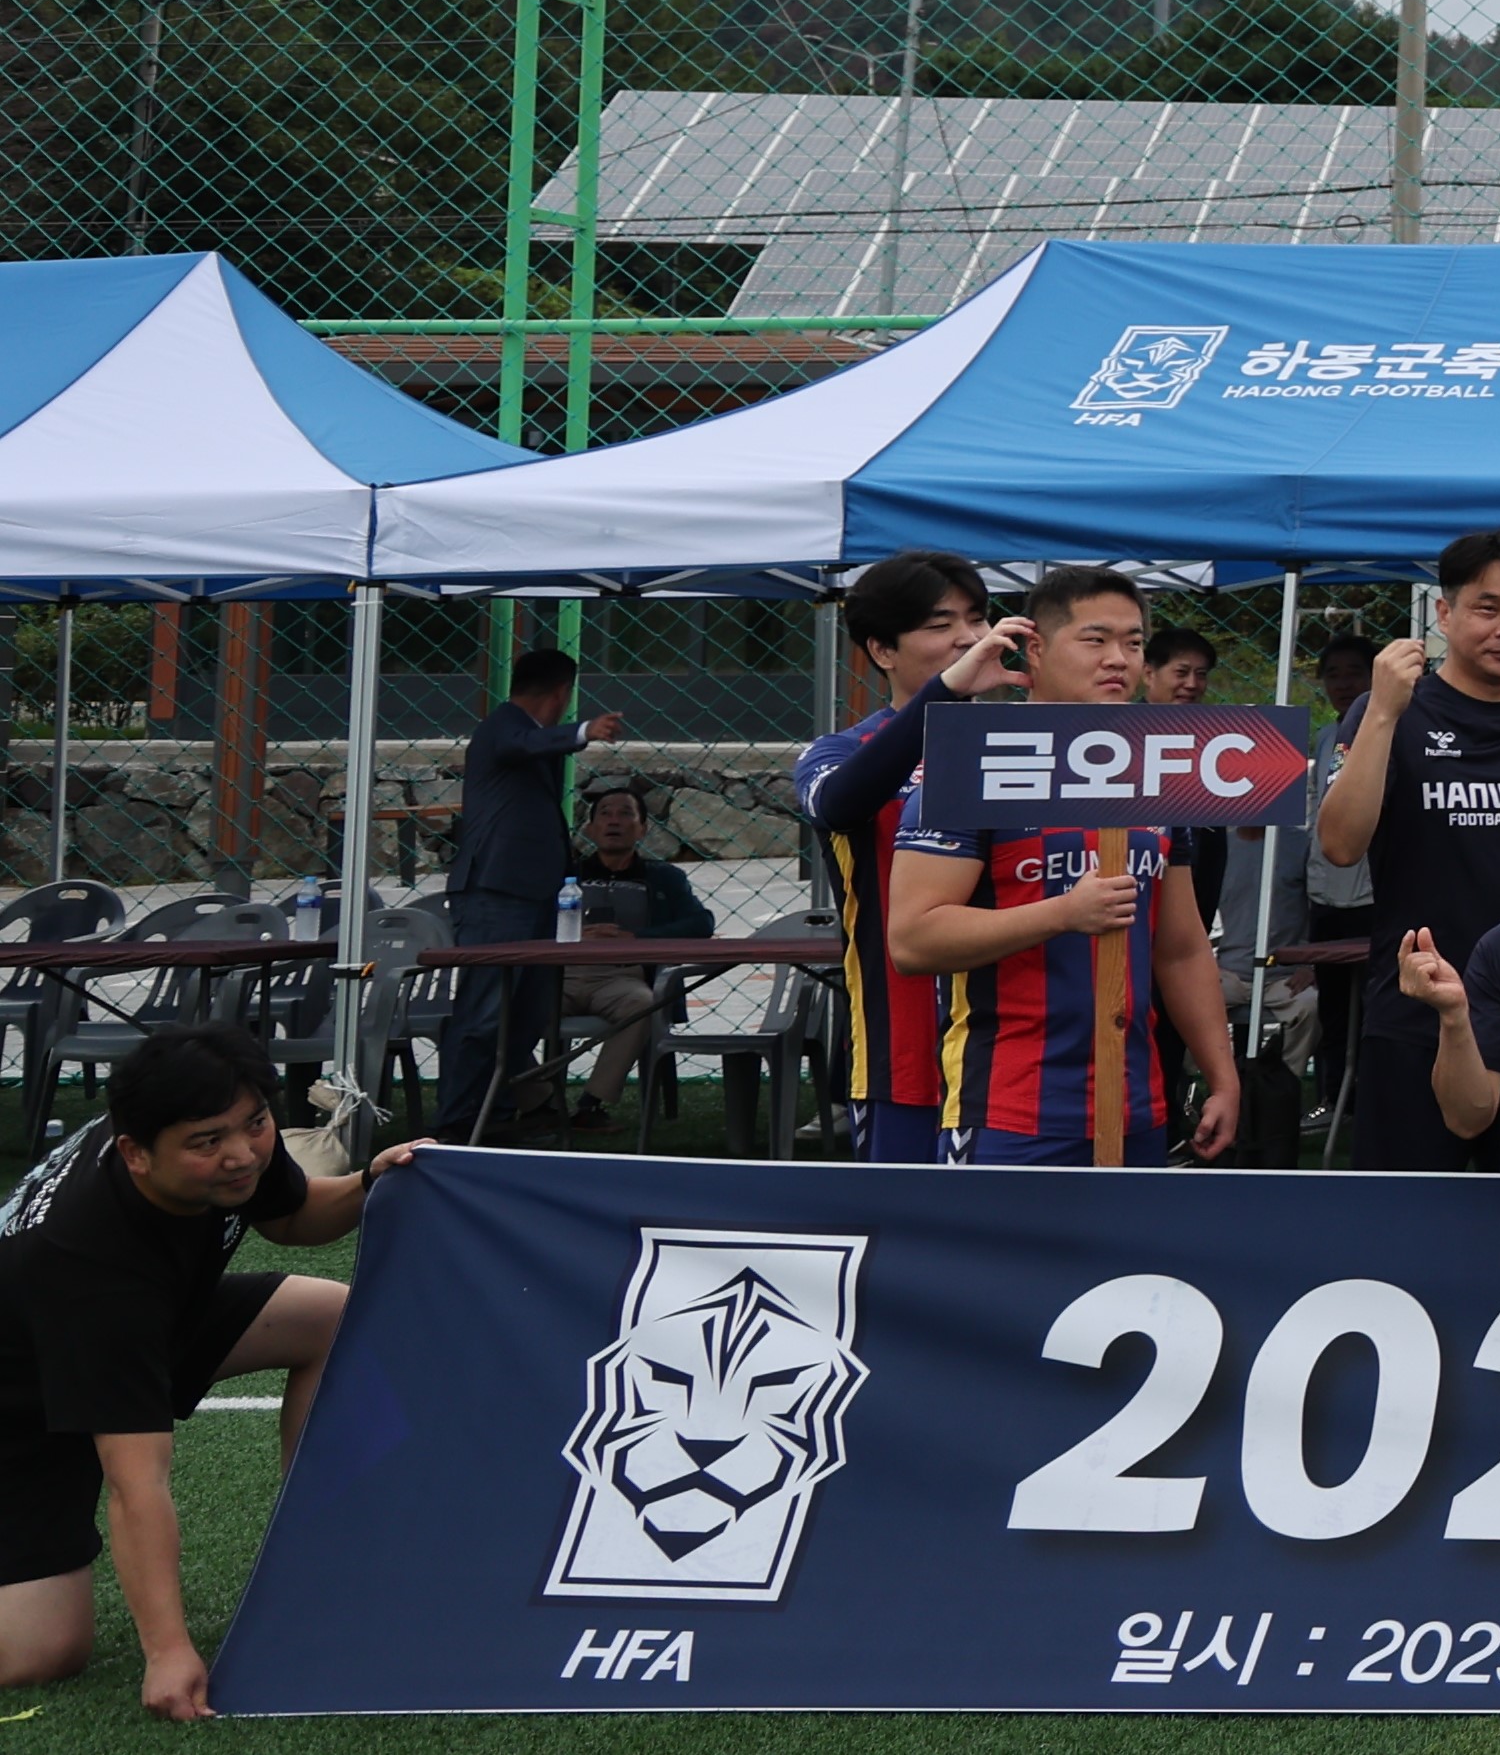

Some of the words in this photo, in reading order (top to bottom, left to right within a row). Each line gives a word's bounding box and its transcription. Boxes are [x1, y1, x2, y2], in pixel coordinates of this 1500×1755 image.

[1223, 384, 1341, 400] HADONG
[1349, 383, 1495, 399] FOOTBALL
[1074, 412, 1142, 427] HFA
[980, 730, 1256, 801] 금오FC
[1424, 746, 1463, 758] hummel
[560, 1629, 694, 1682] HFA
[1111, 1611, 1273, 1686] 일시
